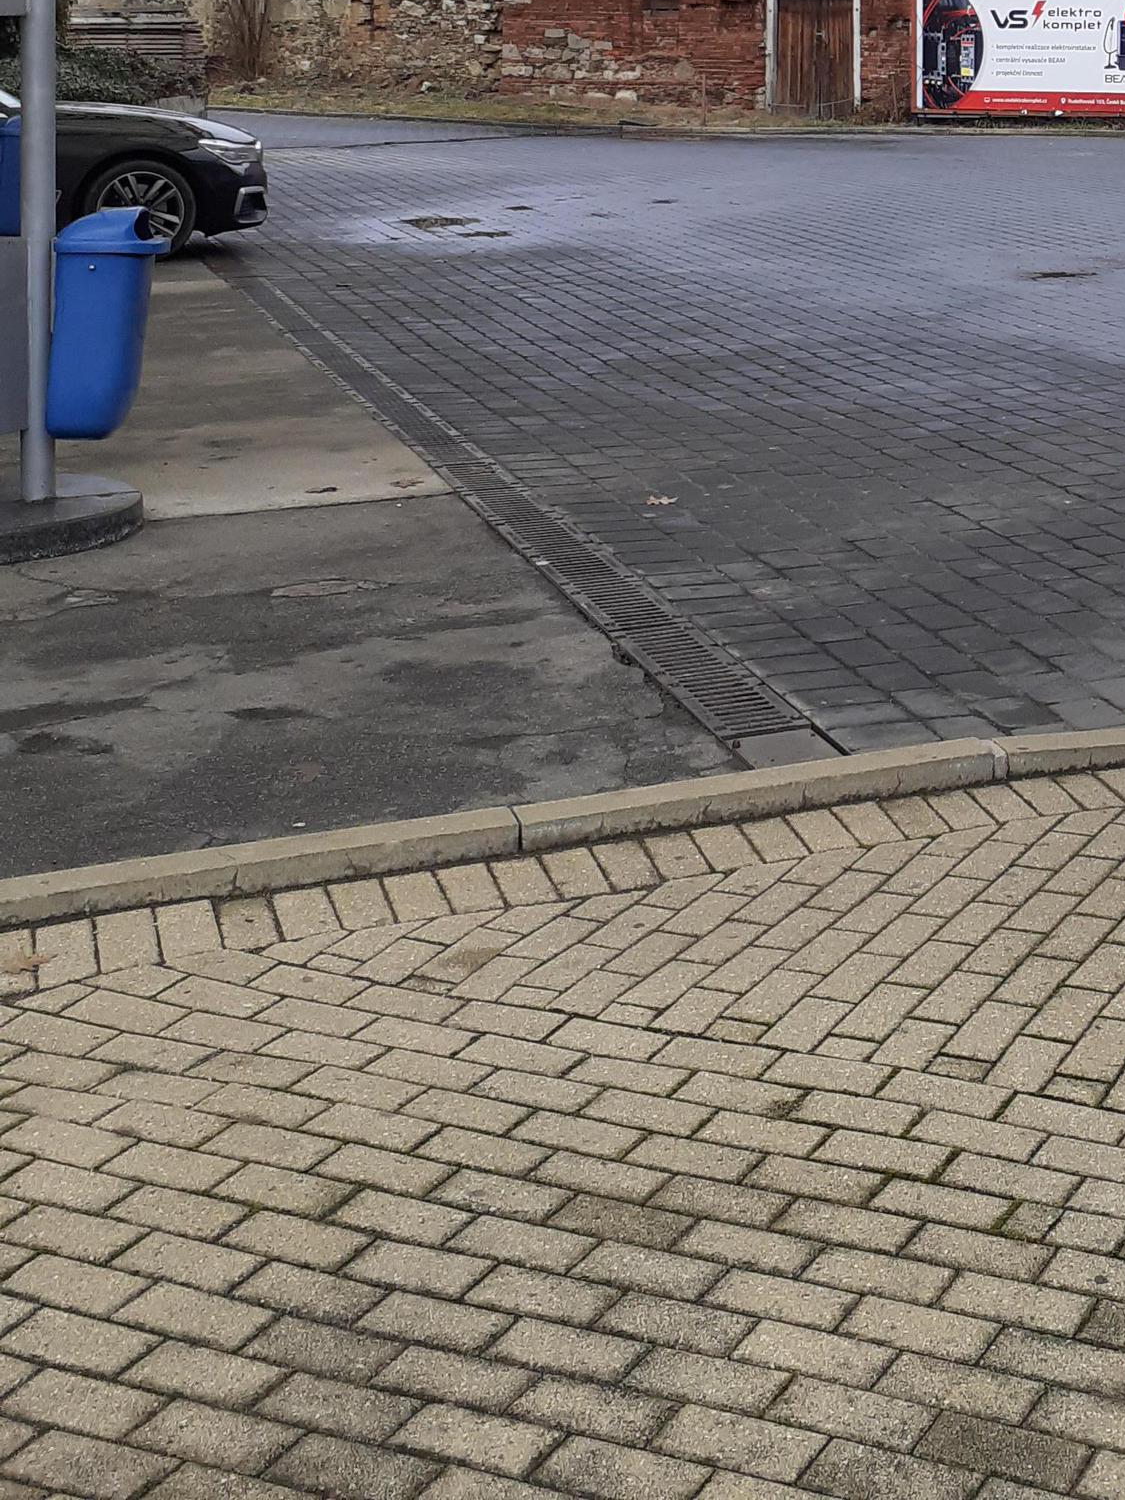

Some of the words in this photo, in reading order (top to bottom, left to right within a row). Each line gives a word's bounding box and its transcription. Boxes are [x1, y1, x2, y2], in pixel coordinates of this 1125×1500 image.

[990, 9, 1029, 29] VS
[1047, 7, 1102, 17] elektro
[1043, 19, 1102, 32] komplet
